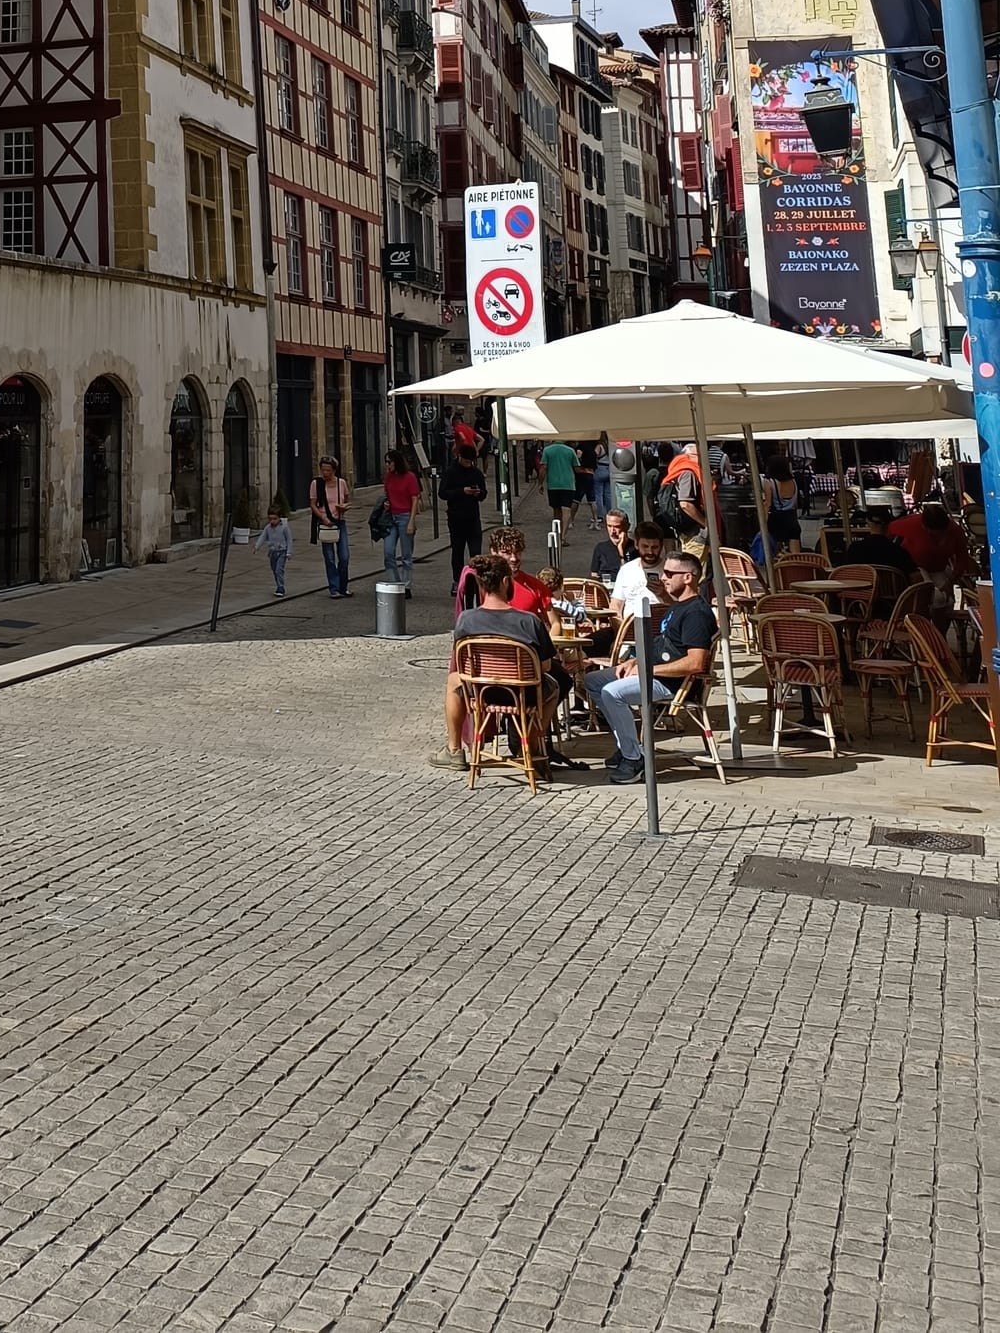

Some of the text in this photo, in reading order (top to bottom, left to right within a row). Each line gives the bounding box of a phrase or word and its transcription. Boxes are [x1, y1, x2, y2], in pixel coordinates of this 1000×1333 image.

[783, 183, 842, 194] BAYONNE
[468, 188, 535, 203] AIRE PIÉTONNE
[776, 196, 852, 207] CORRIDAS
[773, 209, 857, 220] 28, 29 JUILLET
[786, 223, 793, 232] 3
[795, 222, 867, 231] SEPTEMBRE
[788, 250, 849, 259] BAIONAKO
[780, 262, 860, 272] ZEZEN PLAZA
[798, 297, 846, 310] Bayonne
